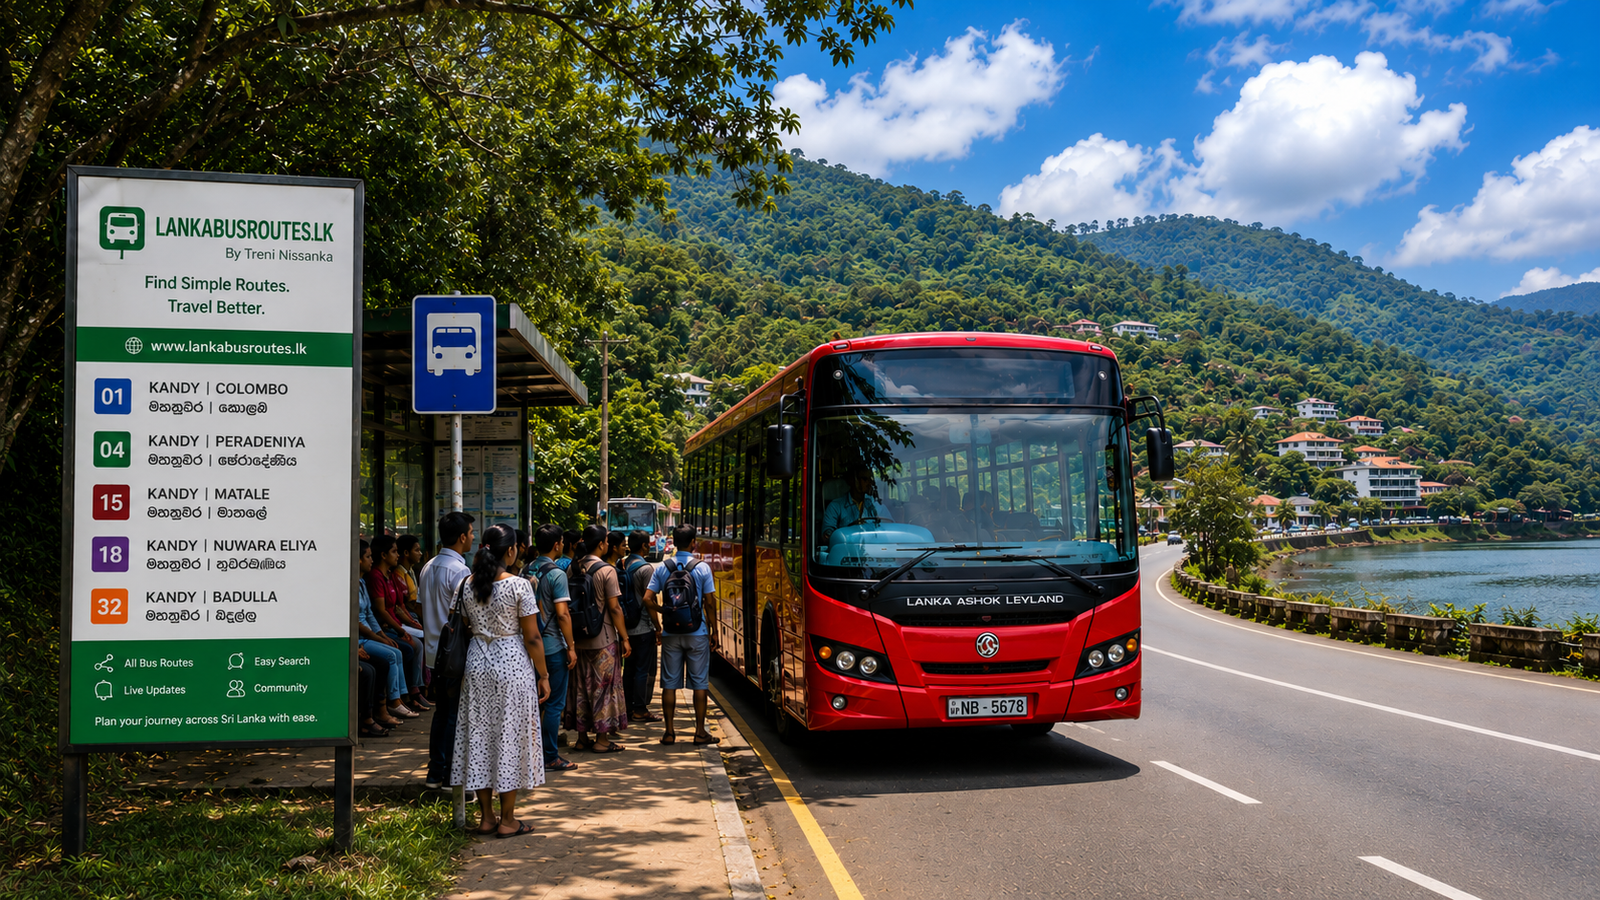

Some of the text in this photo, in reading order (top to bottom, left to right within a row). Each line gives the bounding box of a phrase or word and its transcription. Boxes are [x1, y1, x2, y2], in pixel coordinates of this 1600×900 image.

[156, 216, 334, 242] LANKABUSROUTES.LK
[225, 247, 334, 263] By Treni Nissanka
[144, 275, 290, 294] Find Simple Routes.
[167, 298, 266, 315] Travel Better.
[150, 340, 307, 355] www.lankabusroutes.lk
[149, 381, 289, 396] KANDY COLOMBO
[101, 387, 124, 406] 01
[148, 434, 306, 449] KANDY PERADENIYA
[99, 440, 125, 459] 04
[147, 487, 270, 500] KANDY MATALE
[99, 493, 123, 512] 15
[146, 539, 318, 552] KANDY NUWARA ELIYA
[99, 545, 123, 563] 18
[146, 590, 278, 604] KANDY BADULLA
[906, 595, 1065, 607] LANKA ASHOK LEYLAND
[97, 598, 122, 616] 32
[124, 657, 194, 668] All Bus Routes
[254, 656, 311, 668] Easy Search
[124, 685, 187, 697] Live Updates
[253, 682, 309, 694] Community
[961, 701, 979, 715] NB
[991, 699, 1025, 714] 5678
[94, 712, 319, 728] Plan your journey across Sri Lanka with ease.
